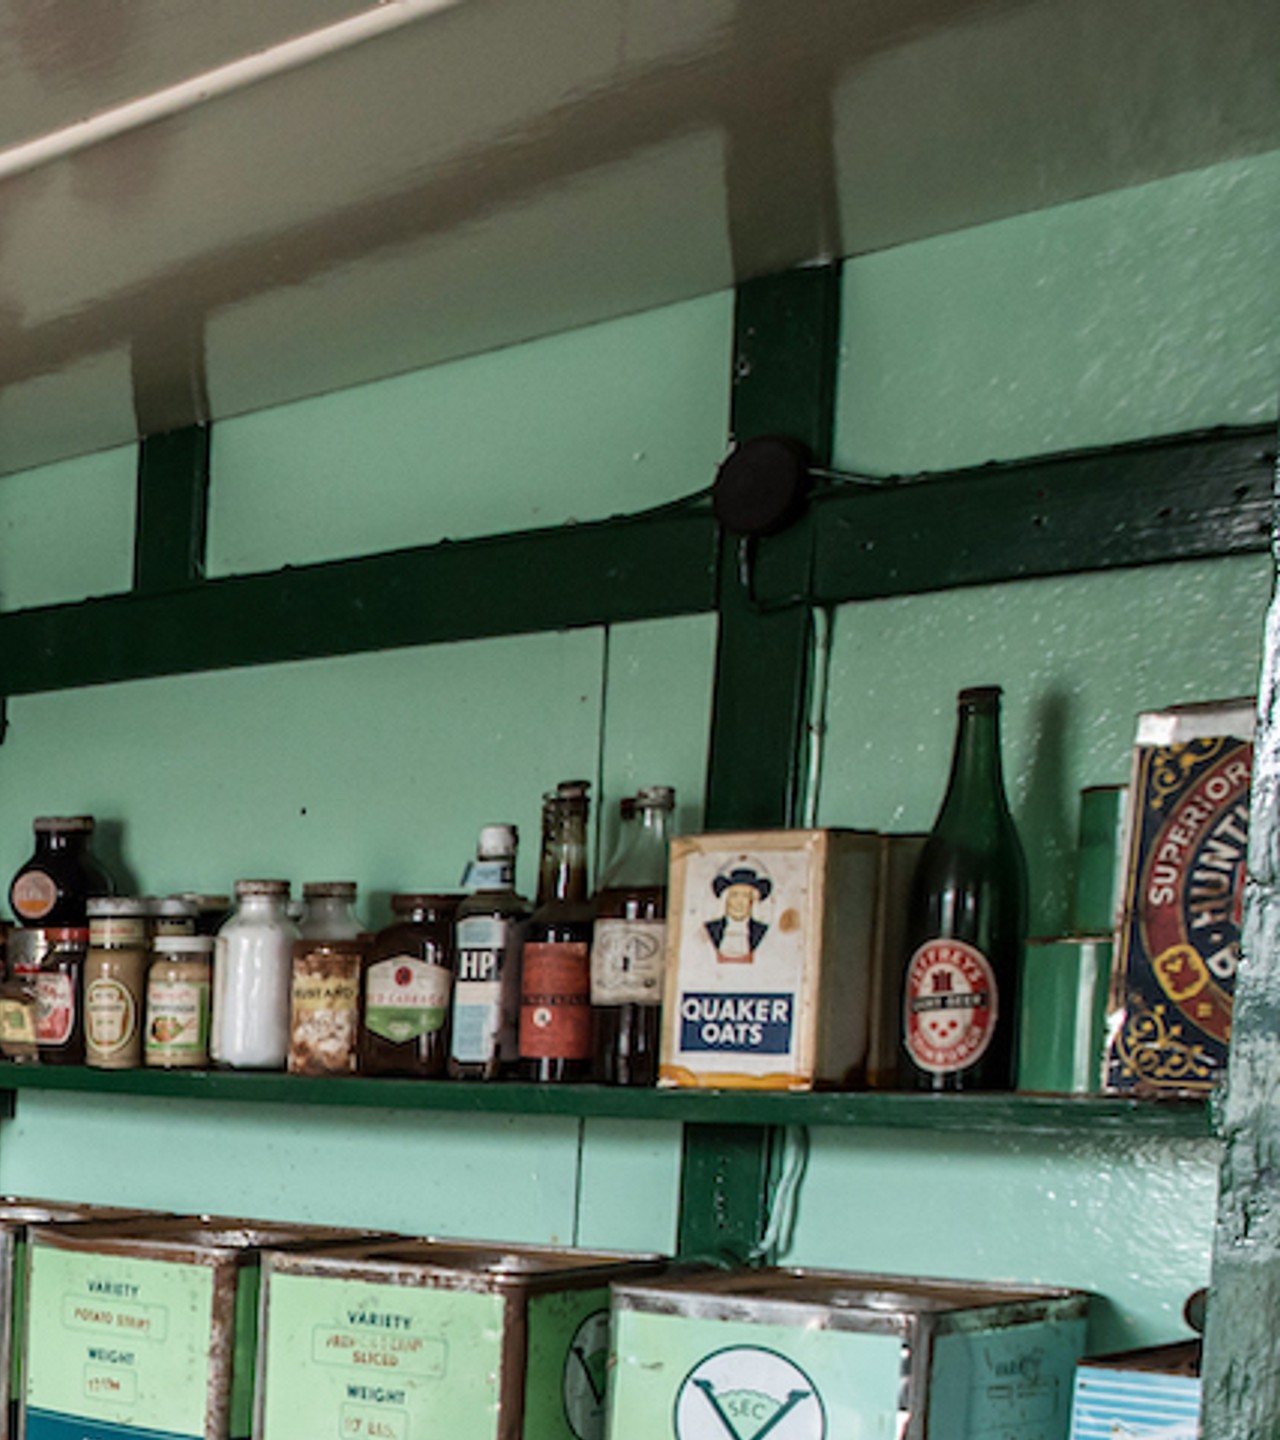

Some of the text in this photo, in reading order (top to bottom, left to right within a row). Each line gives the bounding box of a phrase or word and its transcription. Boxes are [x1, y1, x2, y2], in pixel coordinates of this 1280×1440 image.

[1149, 760, 1249, 905] SUPERIOR
[460, 951, 496, 981] HP
[681, 999, 788, 1023] QUAKER
[701, 1022, 763, 1045] OATS
[87, 1280, 140, 1299] VARIETY
[347, 1310, 413, 1330] VARIETY
[87, 1346, 135, 1365] WEIGHT
[352, 1350, 399, 1367] SLICED
[347, 1383, 405, 1404] WEIGHT
[726, 1402, 767, 1420] SEC
